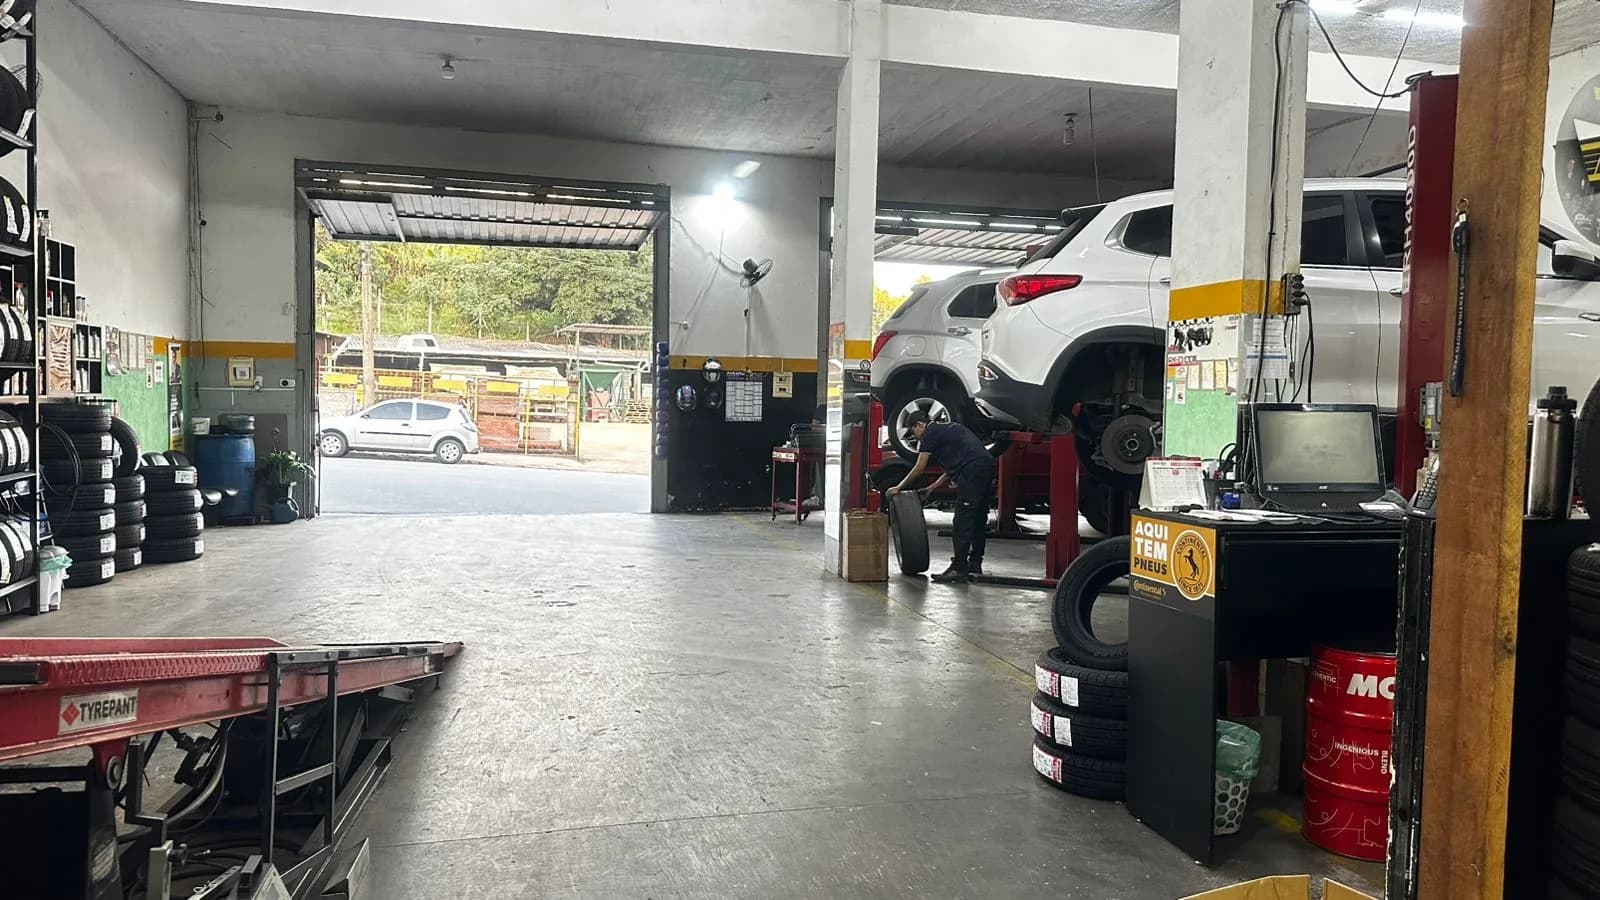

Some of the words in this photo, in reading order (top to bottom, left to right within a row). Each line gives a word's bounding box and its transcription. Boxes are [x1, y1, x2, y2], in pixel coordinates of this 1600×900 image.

[1135, 520, 1168, 540] AQUI
[1134, 536, 1168, 562] TEM
[1134, 556, 1168, 575] PNEUS
[79, 696, 137, 721] TYREPANT
[1334, 741, 1379, 757] INGENIOUS
[1380, 750, 1389, 775] BLEND
